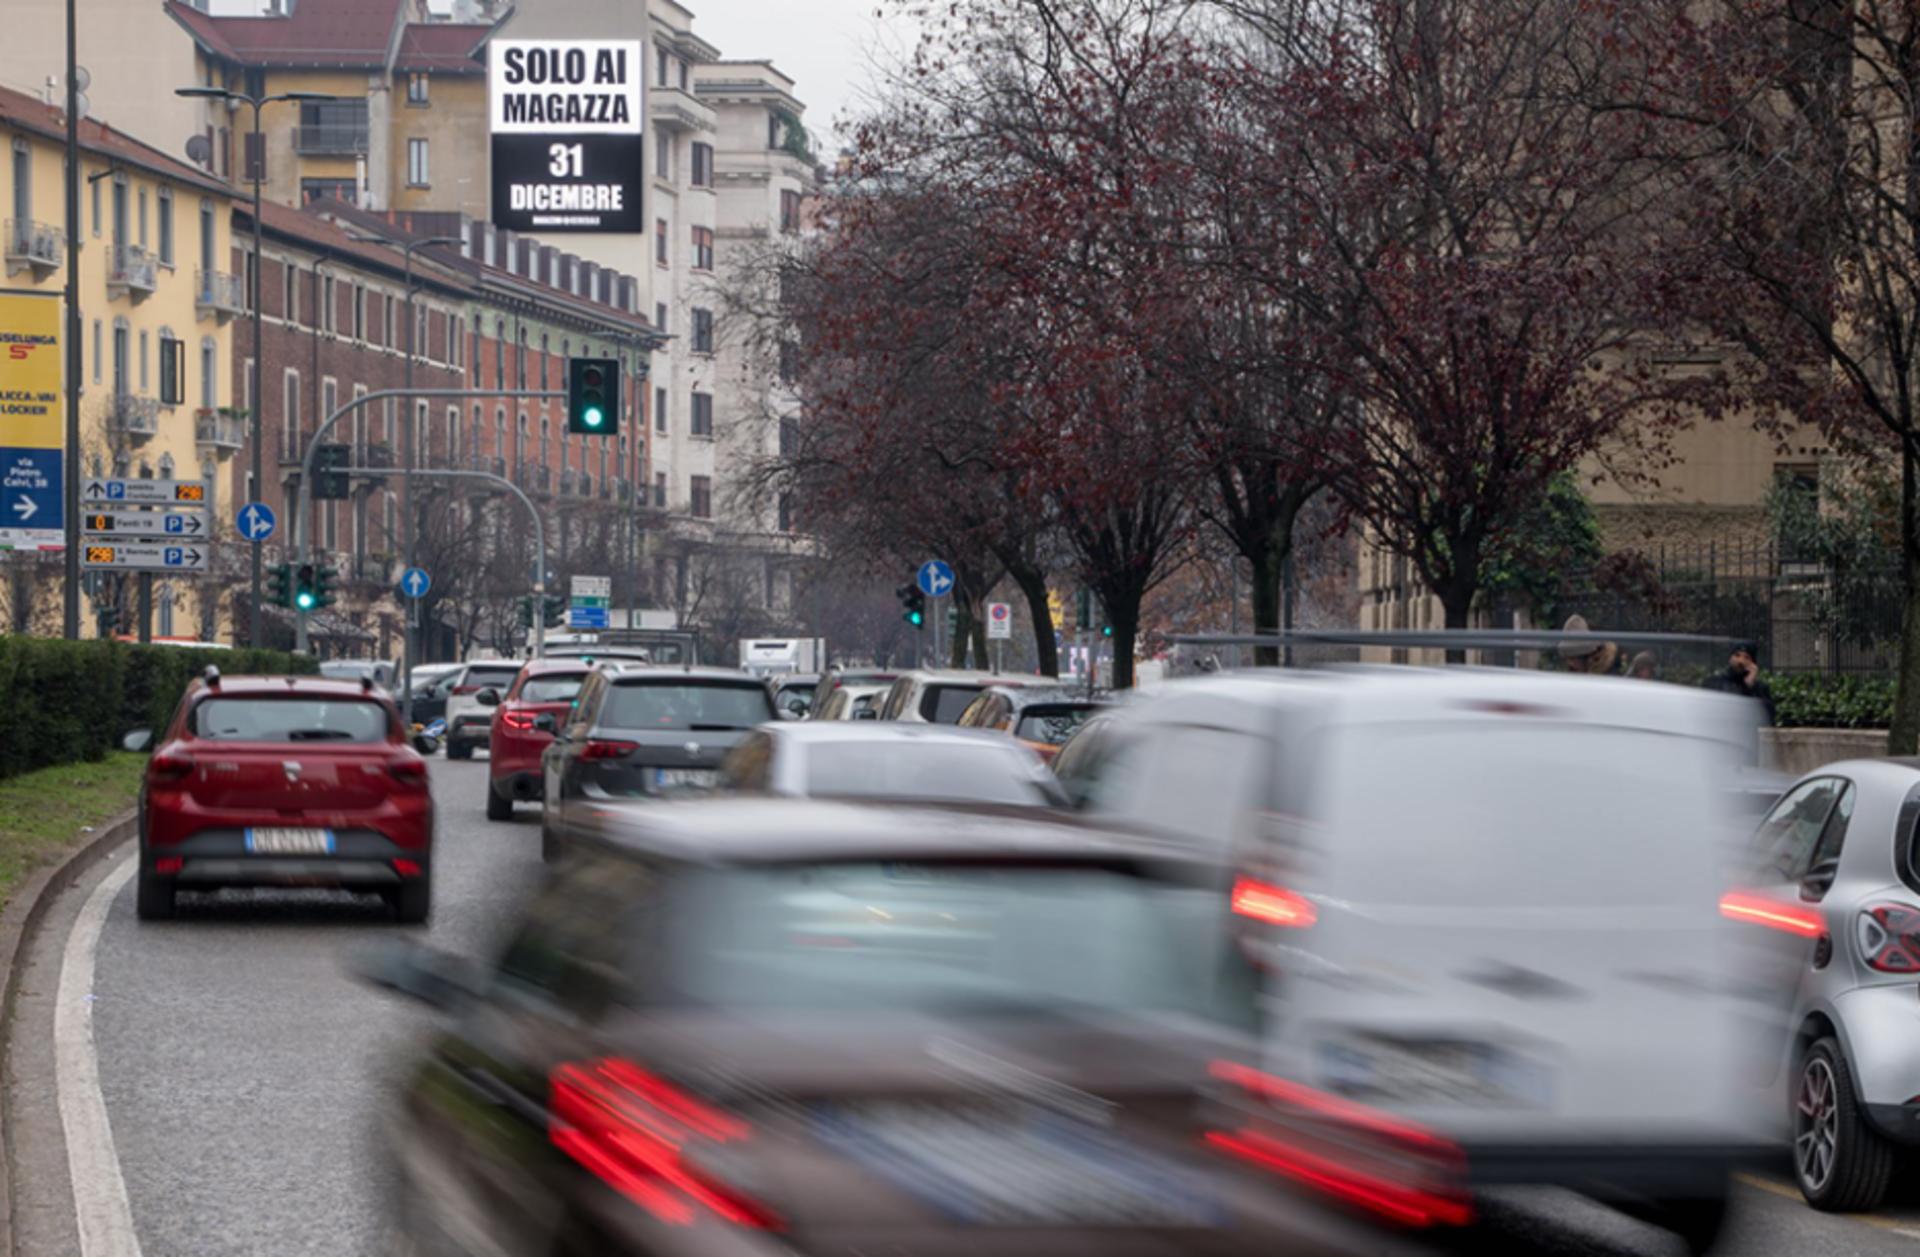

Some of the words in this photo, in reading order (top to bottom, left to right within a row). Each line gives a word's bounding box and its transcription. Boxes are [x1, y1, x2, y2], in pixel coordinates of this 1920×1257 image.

[504, 47, 586, 84] SOLO
[594, 48, 627, 84] AI
[503, 93, 629, 123] MAGAZZA
[549, 143, 583, 177] 31
[510, 184, 623, 210] DICEMBRE
[1, 404, 47, 415] LOCKER
[10, 467, 41, 477] Pietro
